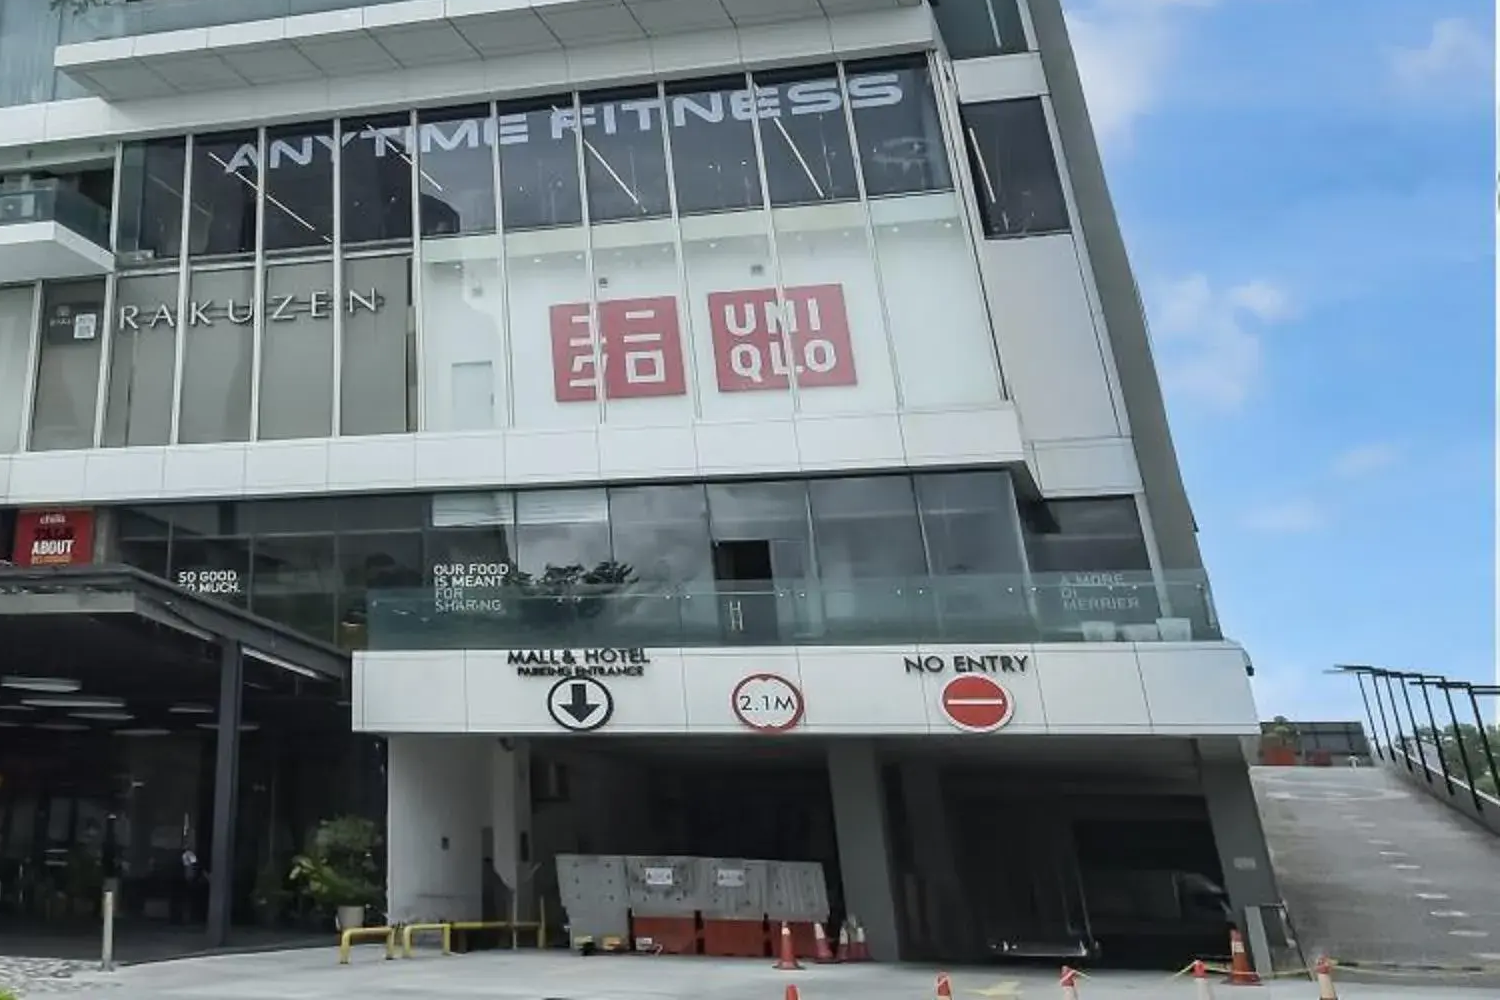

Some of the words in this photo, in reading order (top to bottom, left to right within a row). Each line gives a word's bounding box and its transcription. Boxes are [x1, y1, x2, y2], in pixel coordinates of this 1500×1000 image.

[225, 113, 529, 173] ANYTIME
[550, 73, 902, 139] FITNESS
[118, 286, 378, 330] RAKUZEN
[724, 297, 821, 337] UNI
[730, 339, 838, 383] QLO
[31, 539, 75, 555] ABOUT
[179, 571, 197, 583] SO
[200, 569, 237, 582] GOOD
[433, 563, 465, 575] OUR
[469, 563, 509, 575] FOOD
[434, 575, 449, 587] IS
[452, 575, 505, 587] MEANT
[435, 587, 463, 599] FOR
[435, 599, 501, 613] SHARING
[507, 648, 560, 665] MALL
[562, 649, 577, 665] &
[584, 647, 651, 664] HOTEL
[903, 655, 945, 673] NO
[953, 655, 1029, 673] ENTRY
[517, 665, 572, 677] PARKING
[574, 665, 645, 677] ENTRANCE
[739, 695, 795, 711] 2.1M
